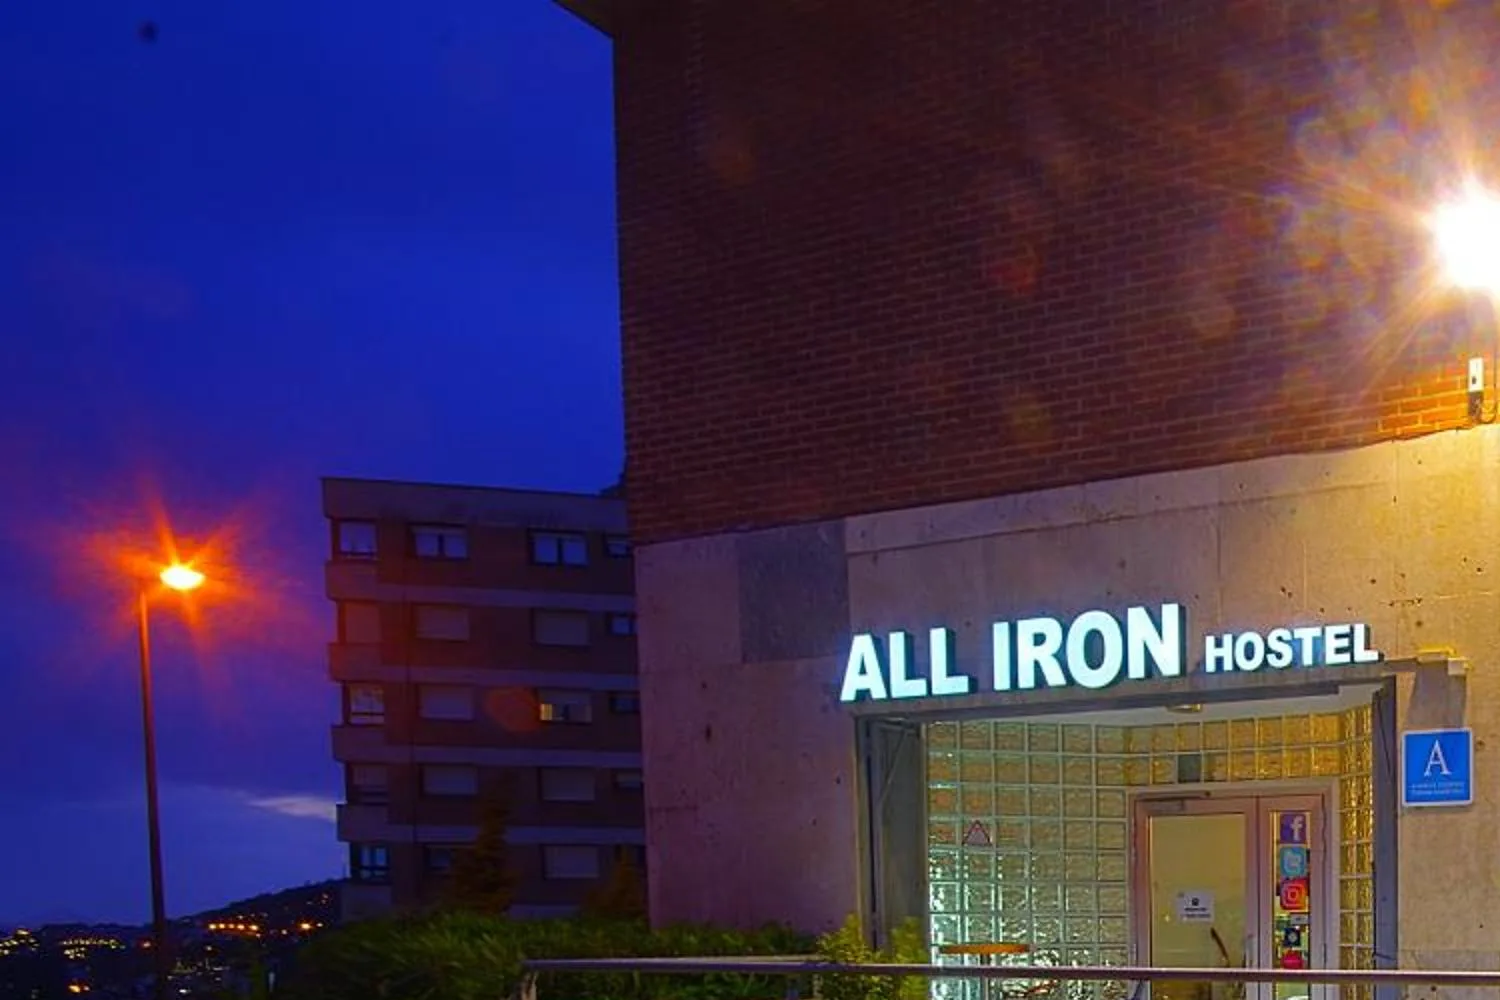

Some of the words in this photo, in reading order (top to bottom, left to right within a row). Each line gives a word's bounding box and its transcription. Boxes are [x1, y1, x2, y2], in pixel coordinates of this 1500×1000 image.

[840, 627, 970, 701] ALL
[993, 603, 1182, 690] IRON
[1205, 623, 1380, 673] HOSTEL
[1423, 739, 1452, 777] A
